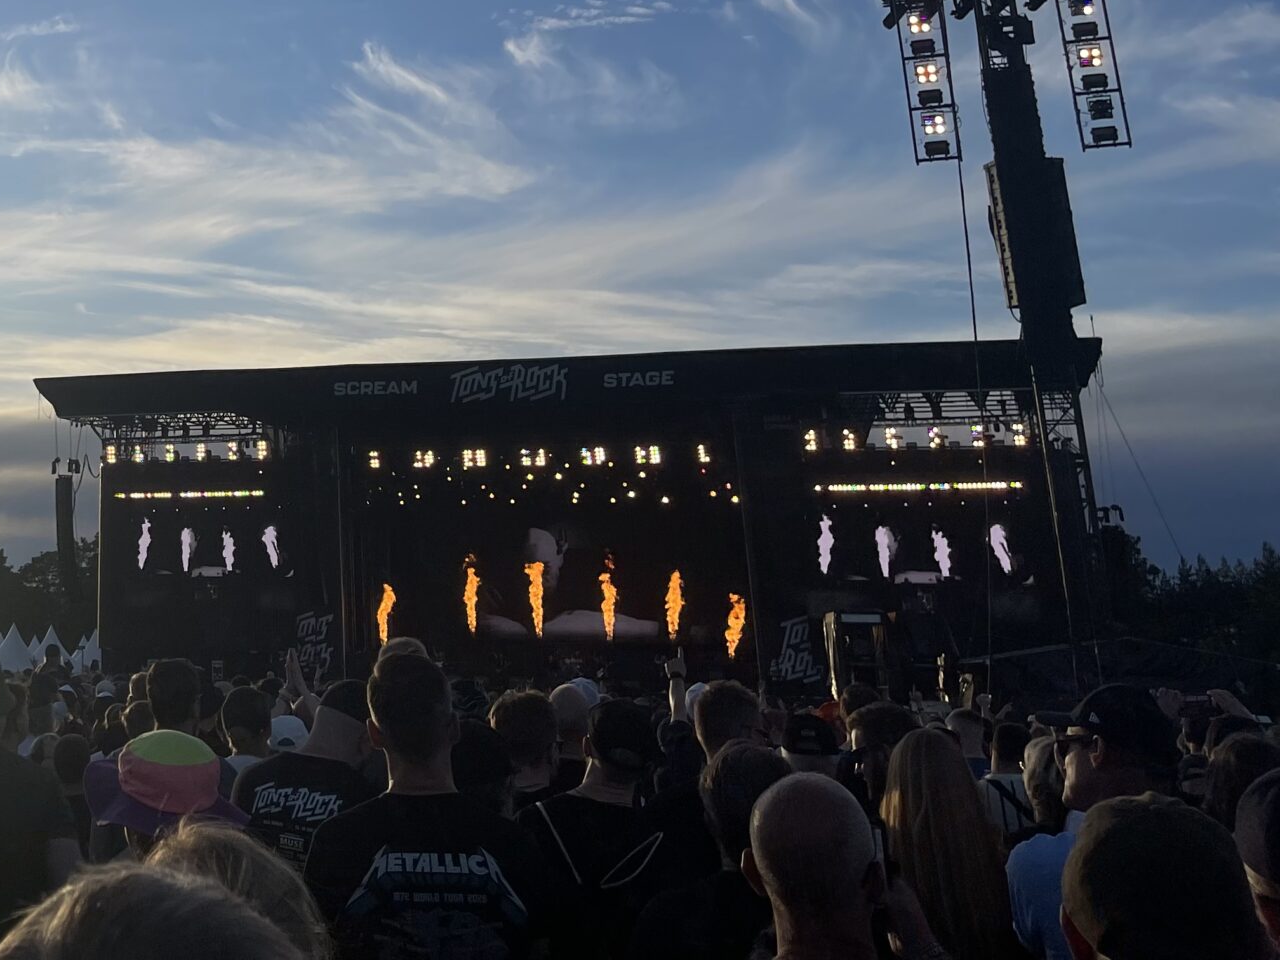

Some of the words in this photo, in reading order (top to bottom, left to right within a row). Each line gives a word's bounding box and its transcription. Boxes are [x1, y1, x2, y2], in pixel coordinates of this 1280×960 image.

[333, 380, 418, 396] SCREAM
[450, 366, 504, 403] TONS
[510, 364, 568, 402] ROCK
[603, 370, 675, 388] STAGE
[251, 781, 293, 814] TONS
[344, 844, 527, 912] METALLICA
